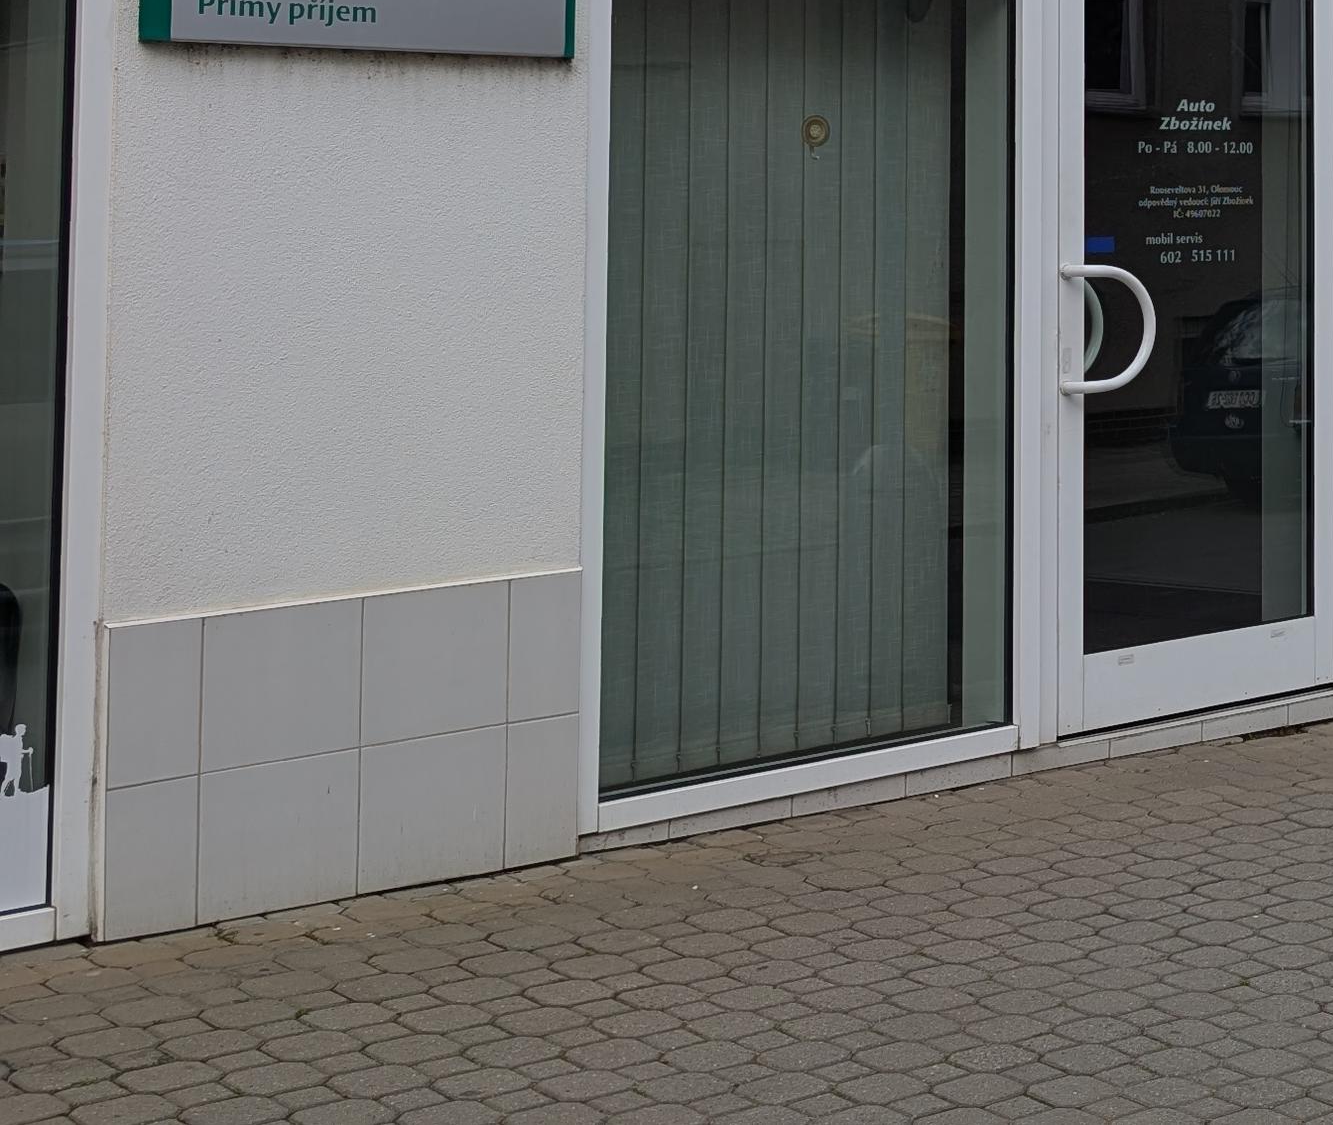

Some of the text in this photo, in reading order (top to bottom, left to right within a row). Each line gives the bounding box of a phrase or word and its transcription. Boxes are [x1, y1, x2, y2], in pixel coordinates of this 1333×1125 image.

[1176, 98, 1215, 113] Auto
[1159, 116, 1232, 131] Zbožínek
[1137, 141, 1153, 154] Po
[1163, 140, 1177, 154] Pá
[1187, 141, 1212, 154] 8.00
[1223, 141, 1253, 154] 12.00
[1146, 232, 1203, 245] mobil servis
[1160, 249, 1236, 264] 602 515 111
